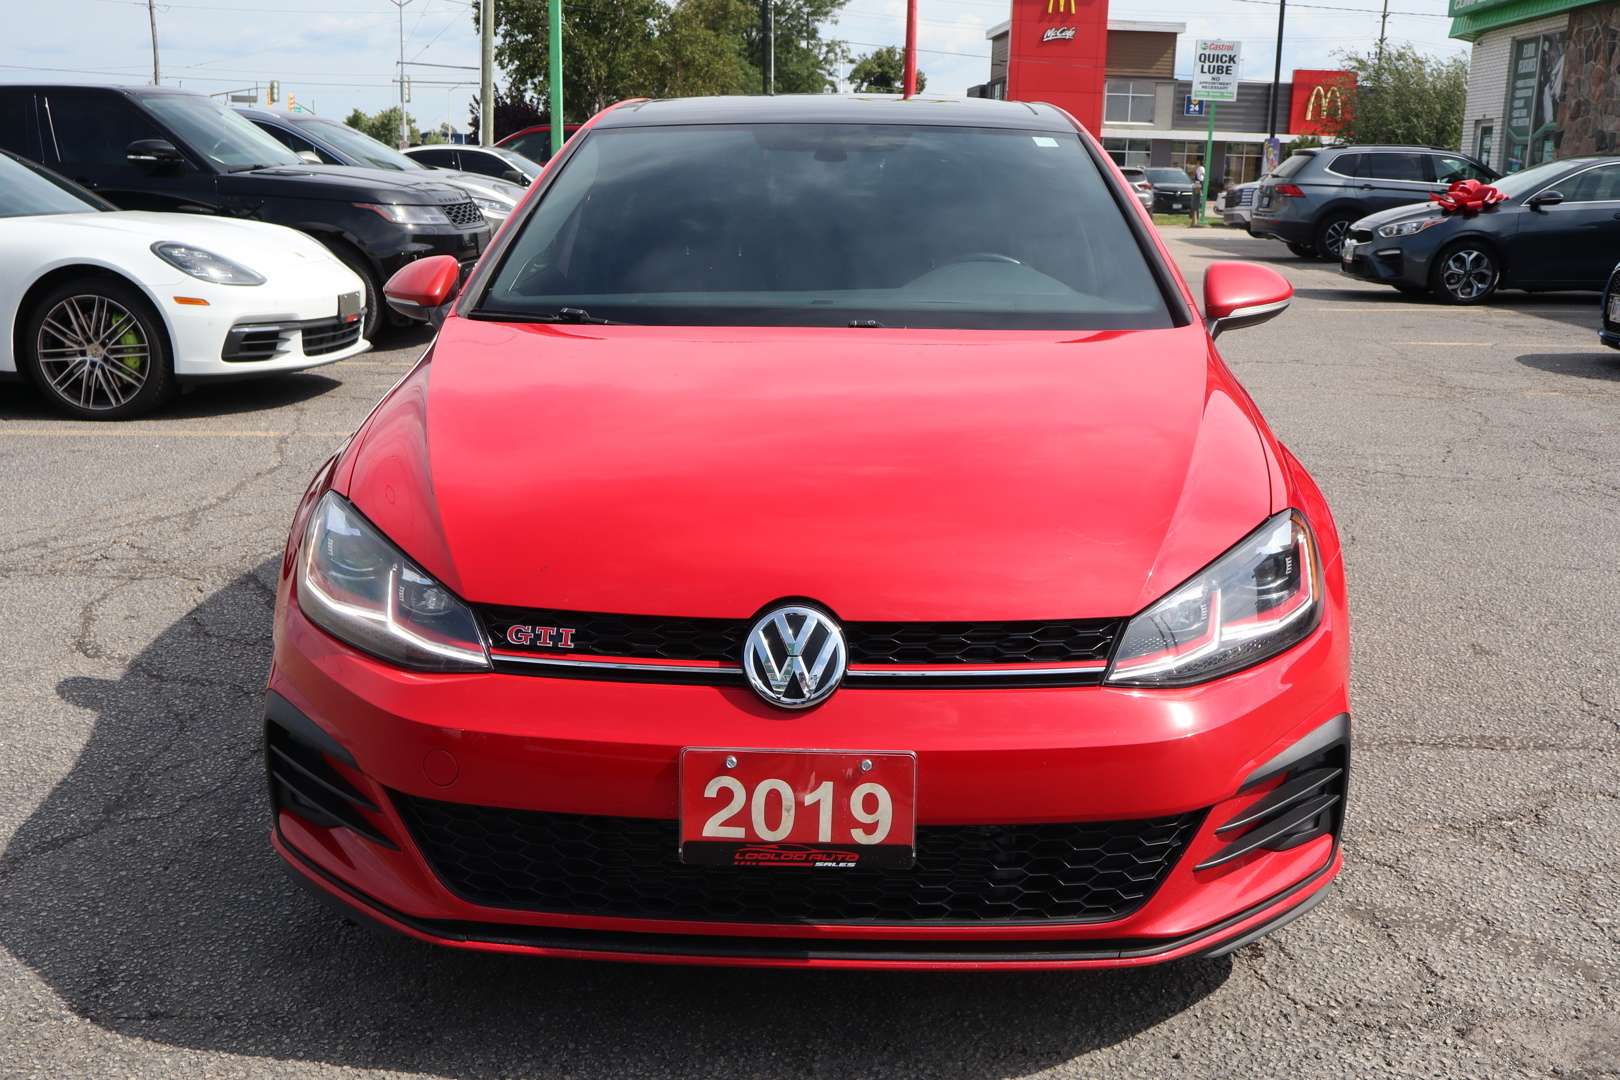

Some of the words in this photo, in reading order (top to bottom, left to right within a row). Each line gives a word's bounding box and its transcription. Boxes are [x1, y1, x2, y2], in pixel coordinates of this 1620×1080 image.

[1209, 43, 1233, 51] Castrol
[1199, 53, 1237, 64] QUICK
[1200, 64, 1233, 75] LUBE
[506, 624, 576, 648] GTI
[702, 775, 893, 845] 2019
[808, 852, 860, 861] AUTO
